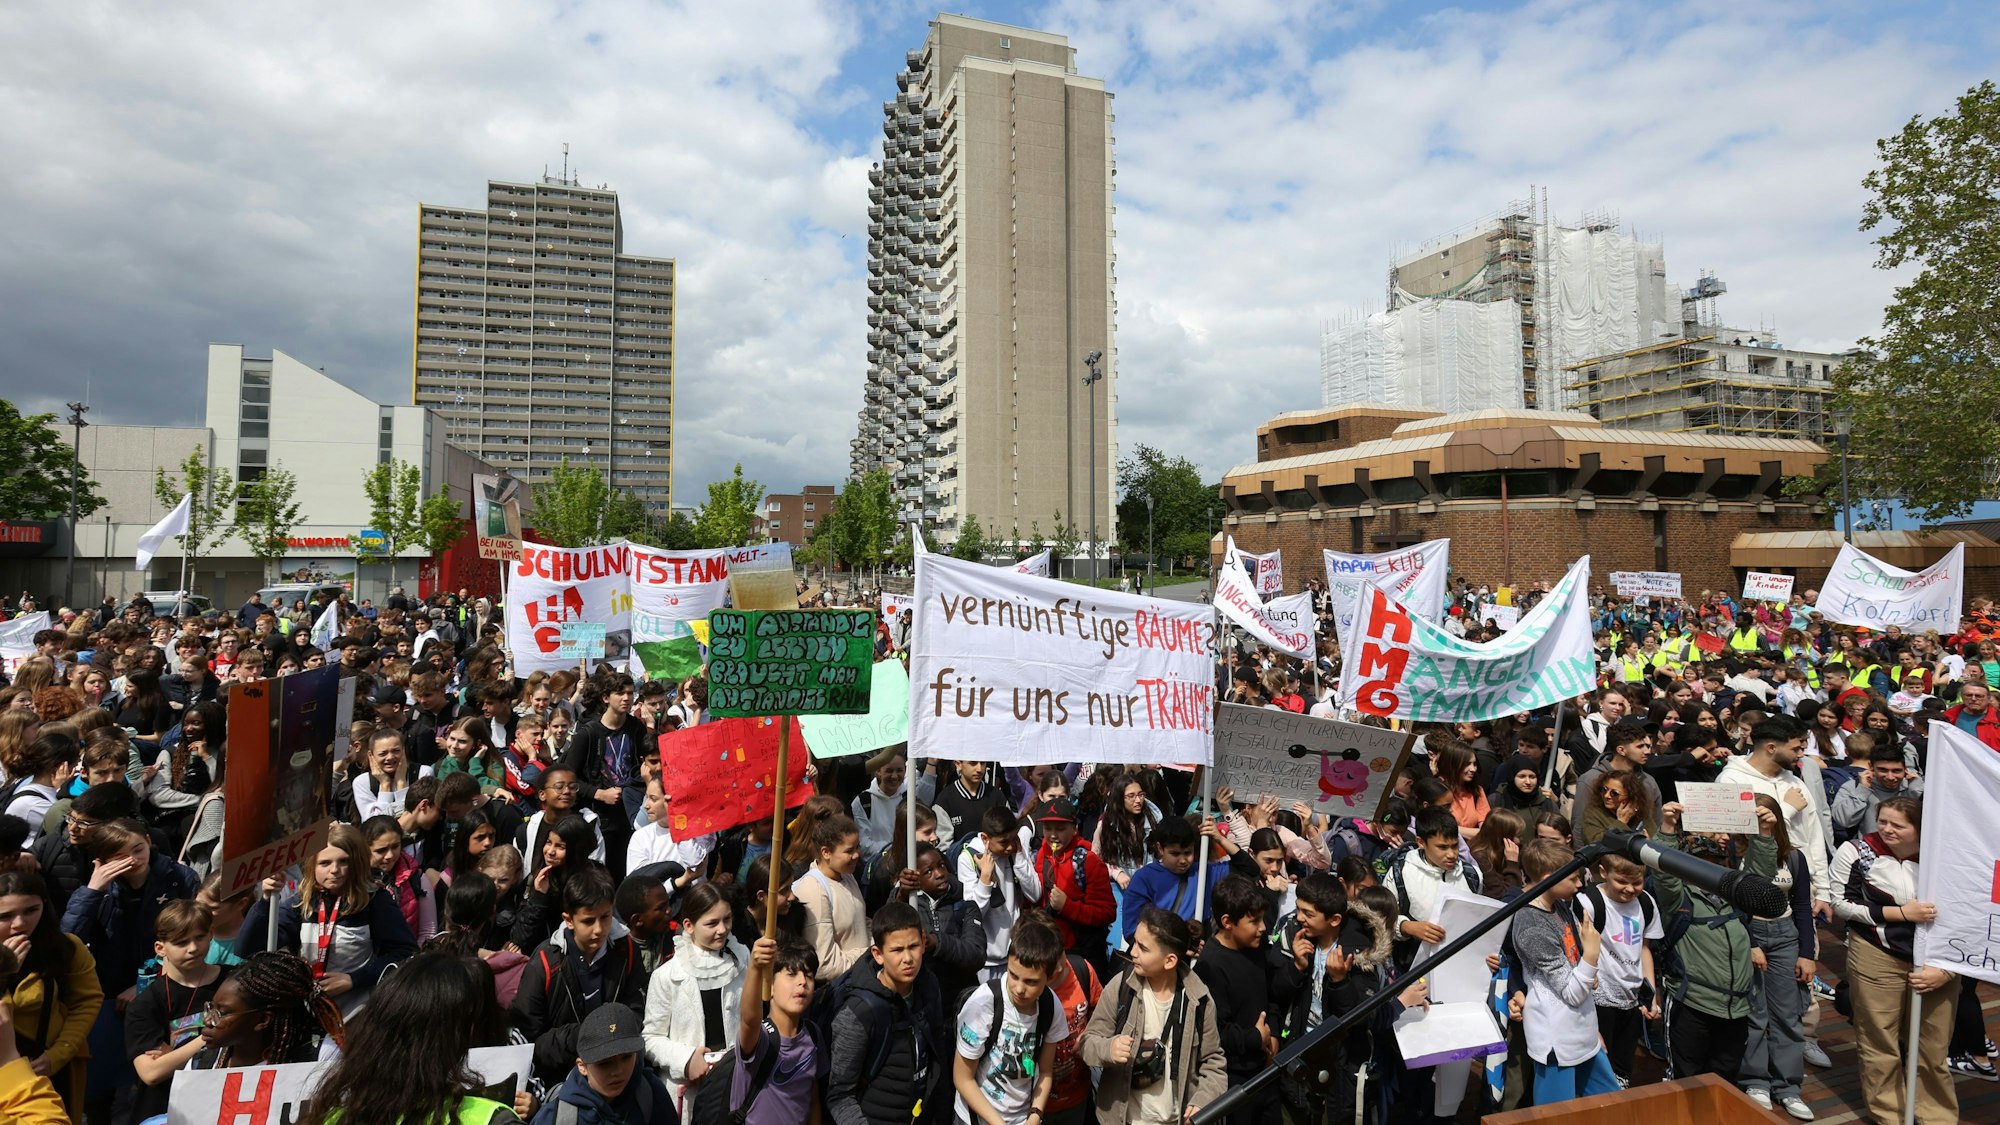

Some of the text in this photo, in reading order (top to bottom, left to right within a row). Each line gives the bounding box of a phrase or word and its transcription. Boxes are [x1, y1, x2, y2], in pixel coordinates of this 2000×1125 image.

[480, 537, 513, 549] BEI UNS
[484, 549, 520, 559] AM HMG
[712, 612, 746, 635] UM
[940, 592, 1129, 659] vernünftige
[711, 635, 848, 662] ZU LERNEN
[709, 659, 857, 685] BRAUCHT MAN
[930, 668, 994, 717] für
[1012, 687, 1069, 726] uns
[1087, 691, 1139, 728] nur
[1369, 733, 1397, 751] WIR
[1268, 777, 1313, 791] NEUE
[232, 831, 315, 891] DEFEKT
